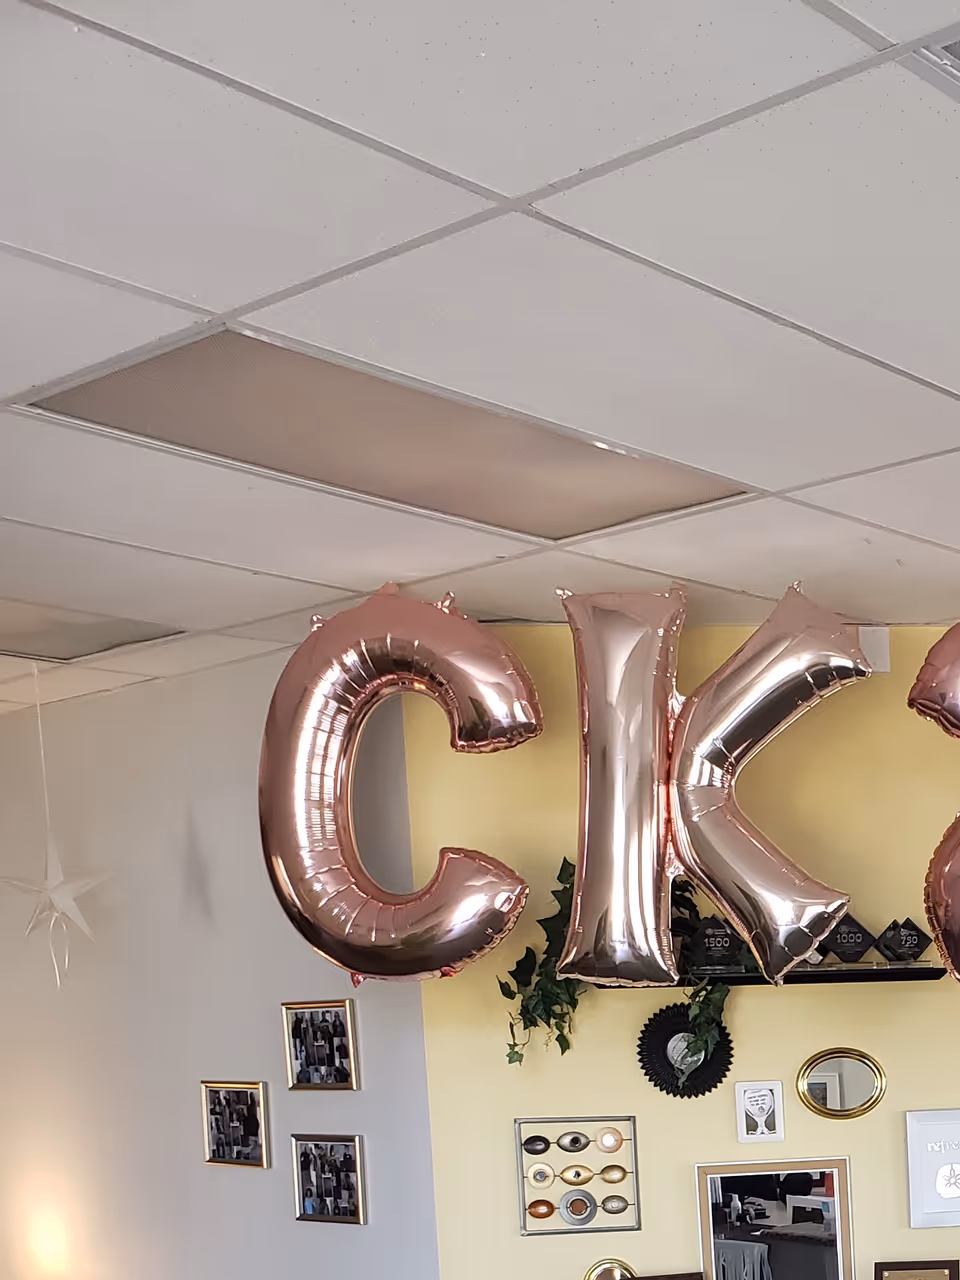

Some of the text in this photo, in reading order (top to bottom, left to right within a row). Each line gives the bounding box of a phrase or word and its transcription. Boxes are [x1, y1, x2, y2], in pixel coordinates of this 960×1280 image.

[704, 937, 730, 948] 1500
[836, 933, 862, 944] 1000
[901, 935, 918, 946] 750
